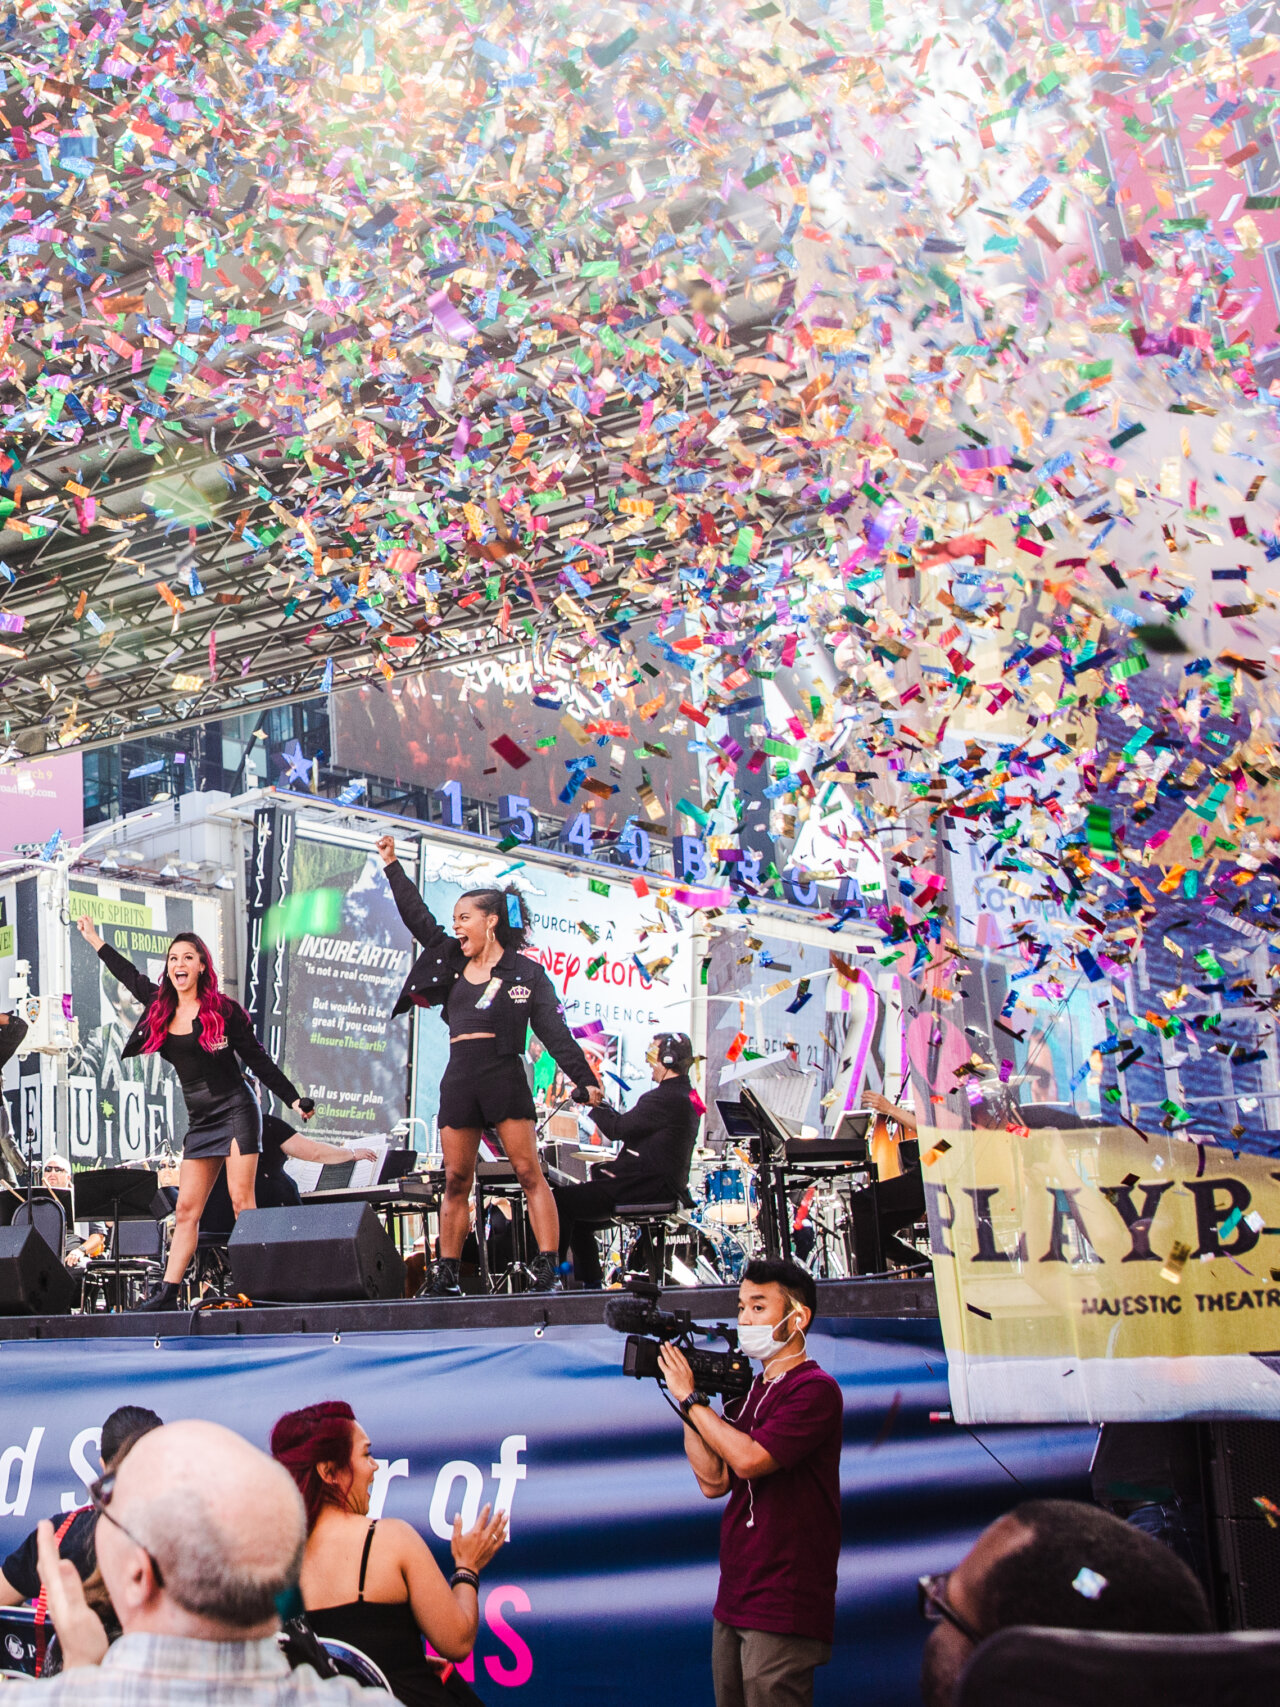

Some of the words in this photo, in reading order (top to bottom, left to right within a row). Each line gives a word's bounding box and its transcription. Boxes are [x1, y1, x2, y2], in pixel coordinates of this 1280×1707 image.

[46, 770, 54, 780] 9
[70, 898, 105, 920] AISING
[108, 903, 145, 927] SPIRITS
[534, 913, 601, 937] PURCHE
[605, 929, 614, 942] A
[114, 929, 129, 949] ON
[131, 931, 175, 954] BROADW
[297, 933, 404, 971] INSUREARTH
[316, 966, 332, 977] not
[332, 968, 339, 978] a
[340, 969, 358, 981] real
[312, 997, 329, 1010] But
[330, 999, 367, 1015] wouldn't
[367, 1004, 375, 1016] it
[376, 1006, 387, 1018] be
[311, 1017, 336, 1028] great
[337, 1017, 345, 1031] if
[345, 1021, 362, 1032] you
[362, 1023, 387, 1035] could
[309, 1033, 387, 1053] #InsureTheEarth?
[308, 1084, 326, 1099] Tell
[326, 1090, 338, 1100] us
[339, 1091, 362, 1103] your
[362, 1090, 384, 1105] plan
[315, 1103, 376, 1121] @InsurEarth
[924, 1173, 1280, 1265] PLAYB
[1081, 1295, 1183, 1317] MAJESTIC
[429, 1434, 527, 1543] of
